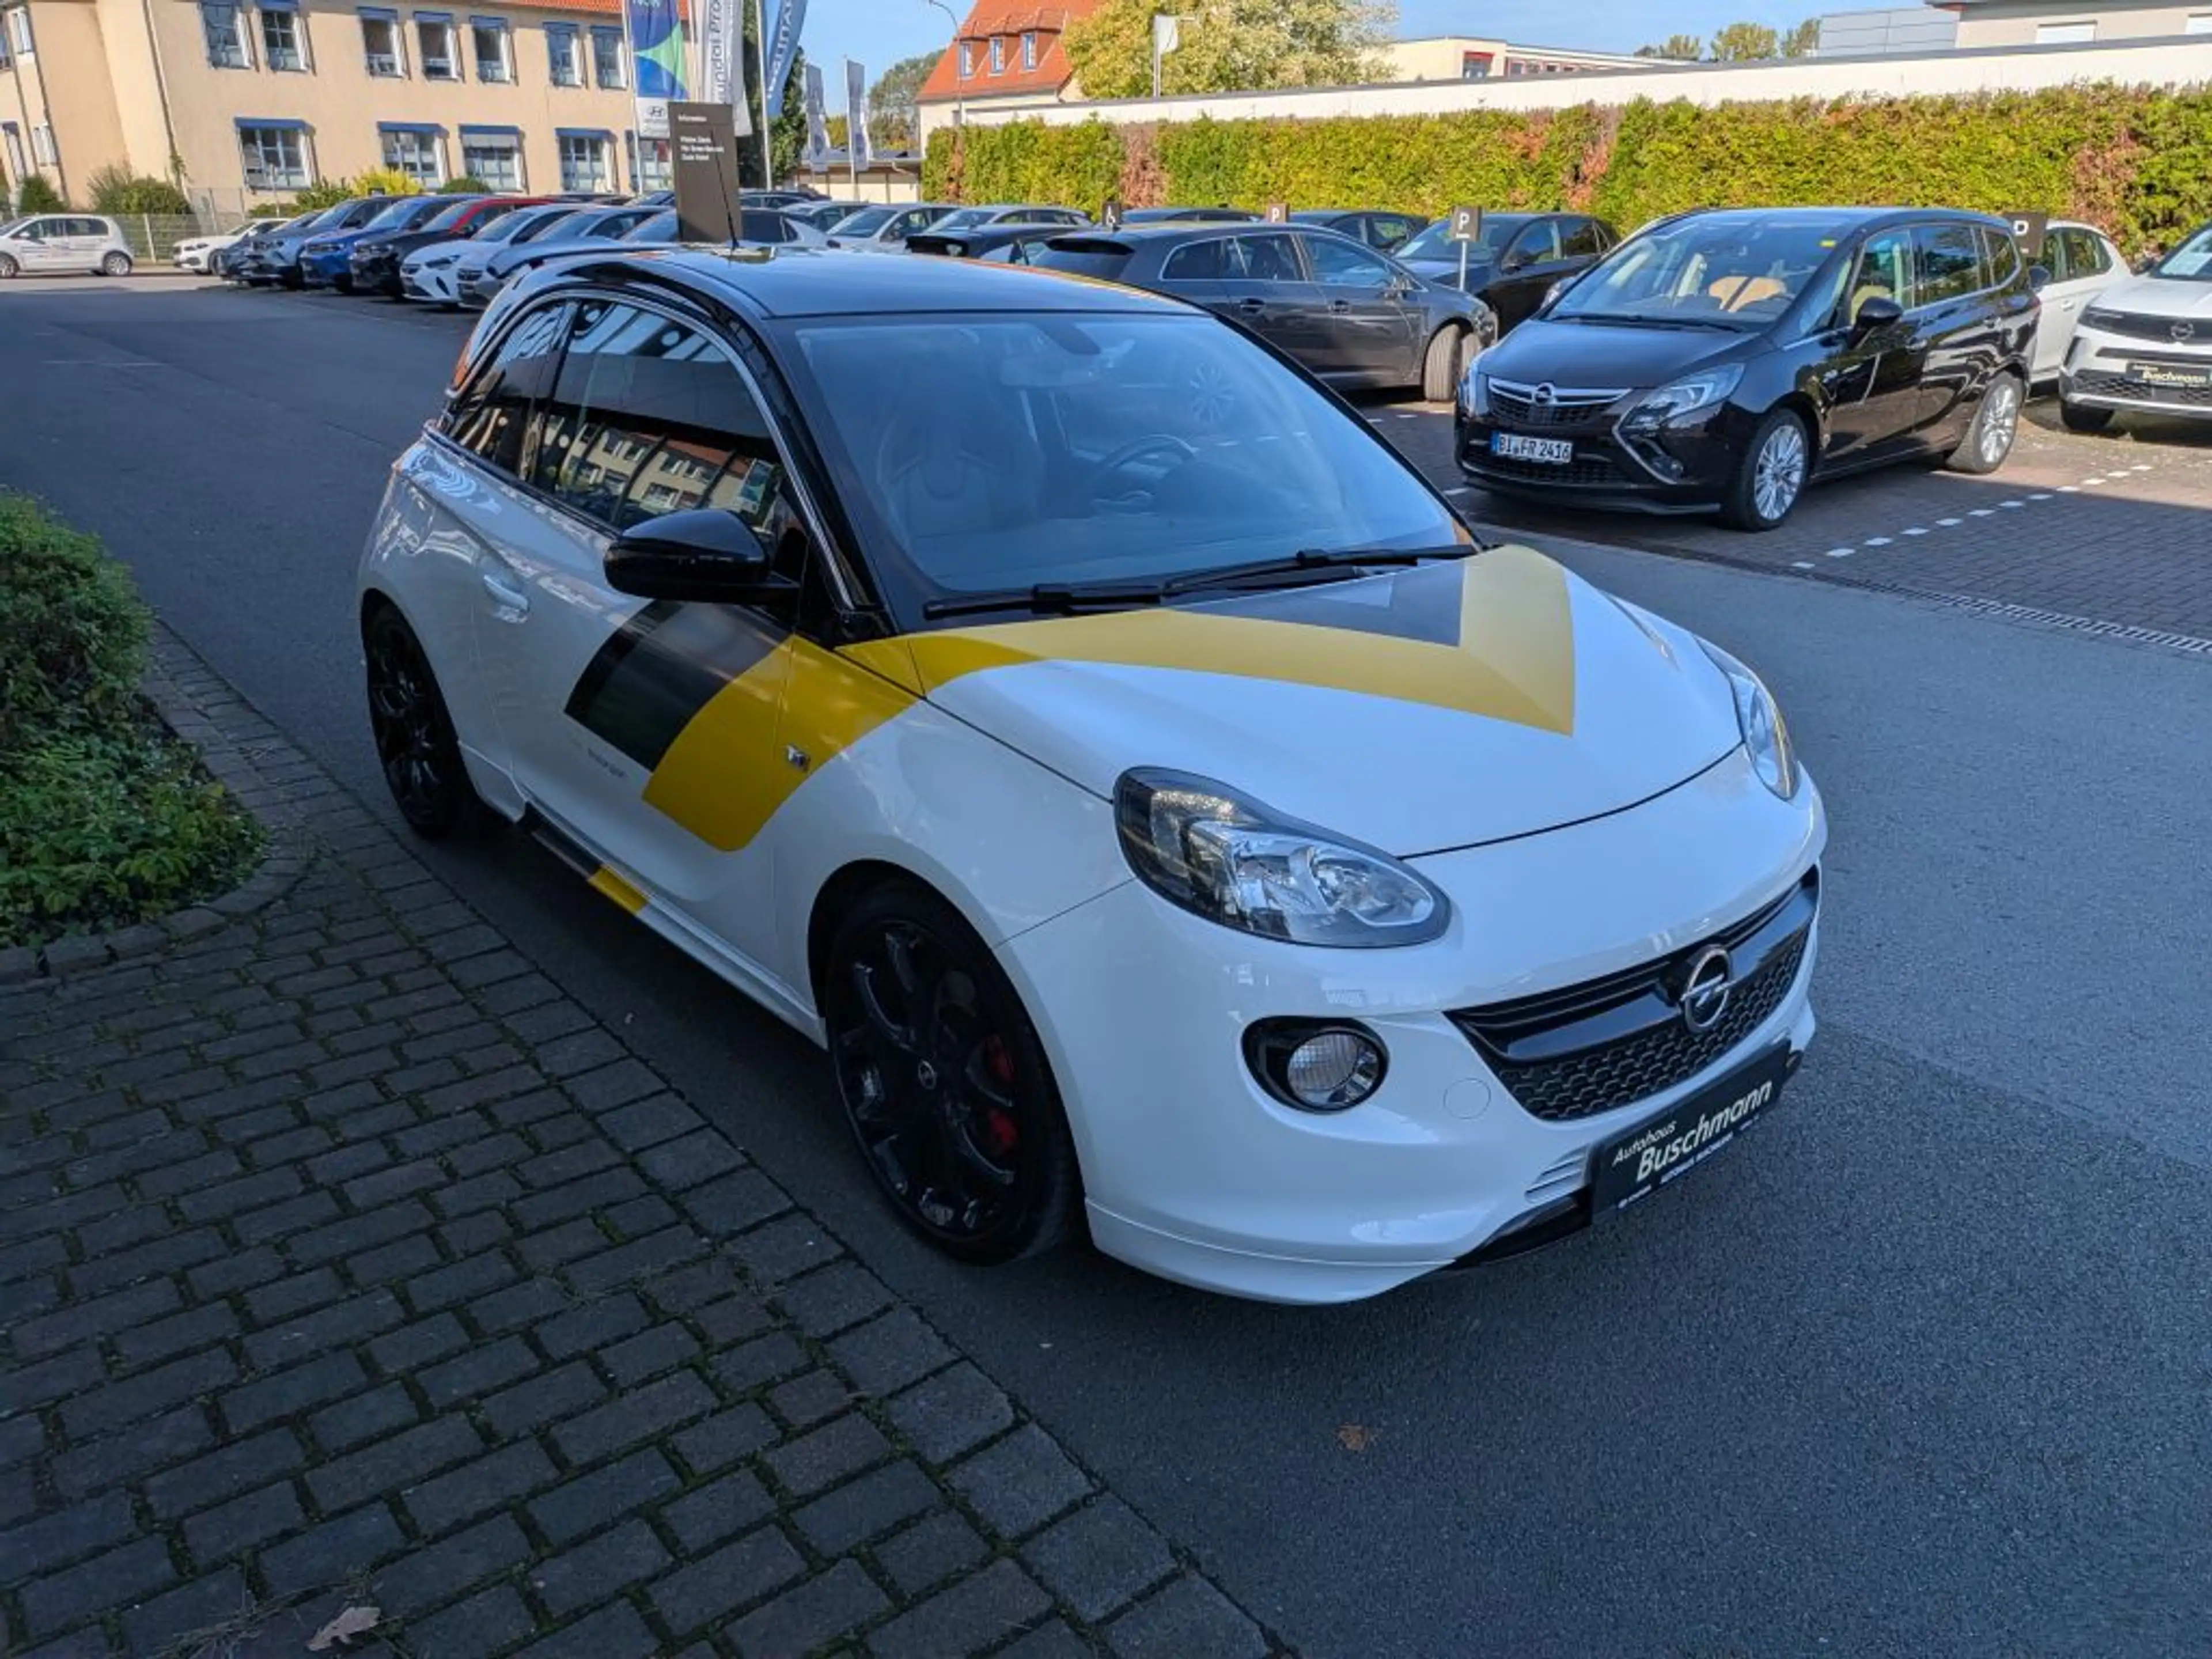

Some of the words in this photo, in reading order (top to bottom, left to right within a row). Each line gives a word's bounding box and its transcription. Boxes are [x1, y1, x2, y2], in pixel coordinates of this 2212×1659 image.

[1272, 207, 1280, 223] P
[1458, 212, 1470, 230] P
[1612, 1120, 1677, 1167] Autohaus
[1636, 1080, 1772, 1181] Buschmann
